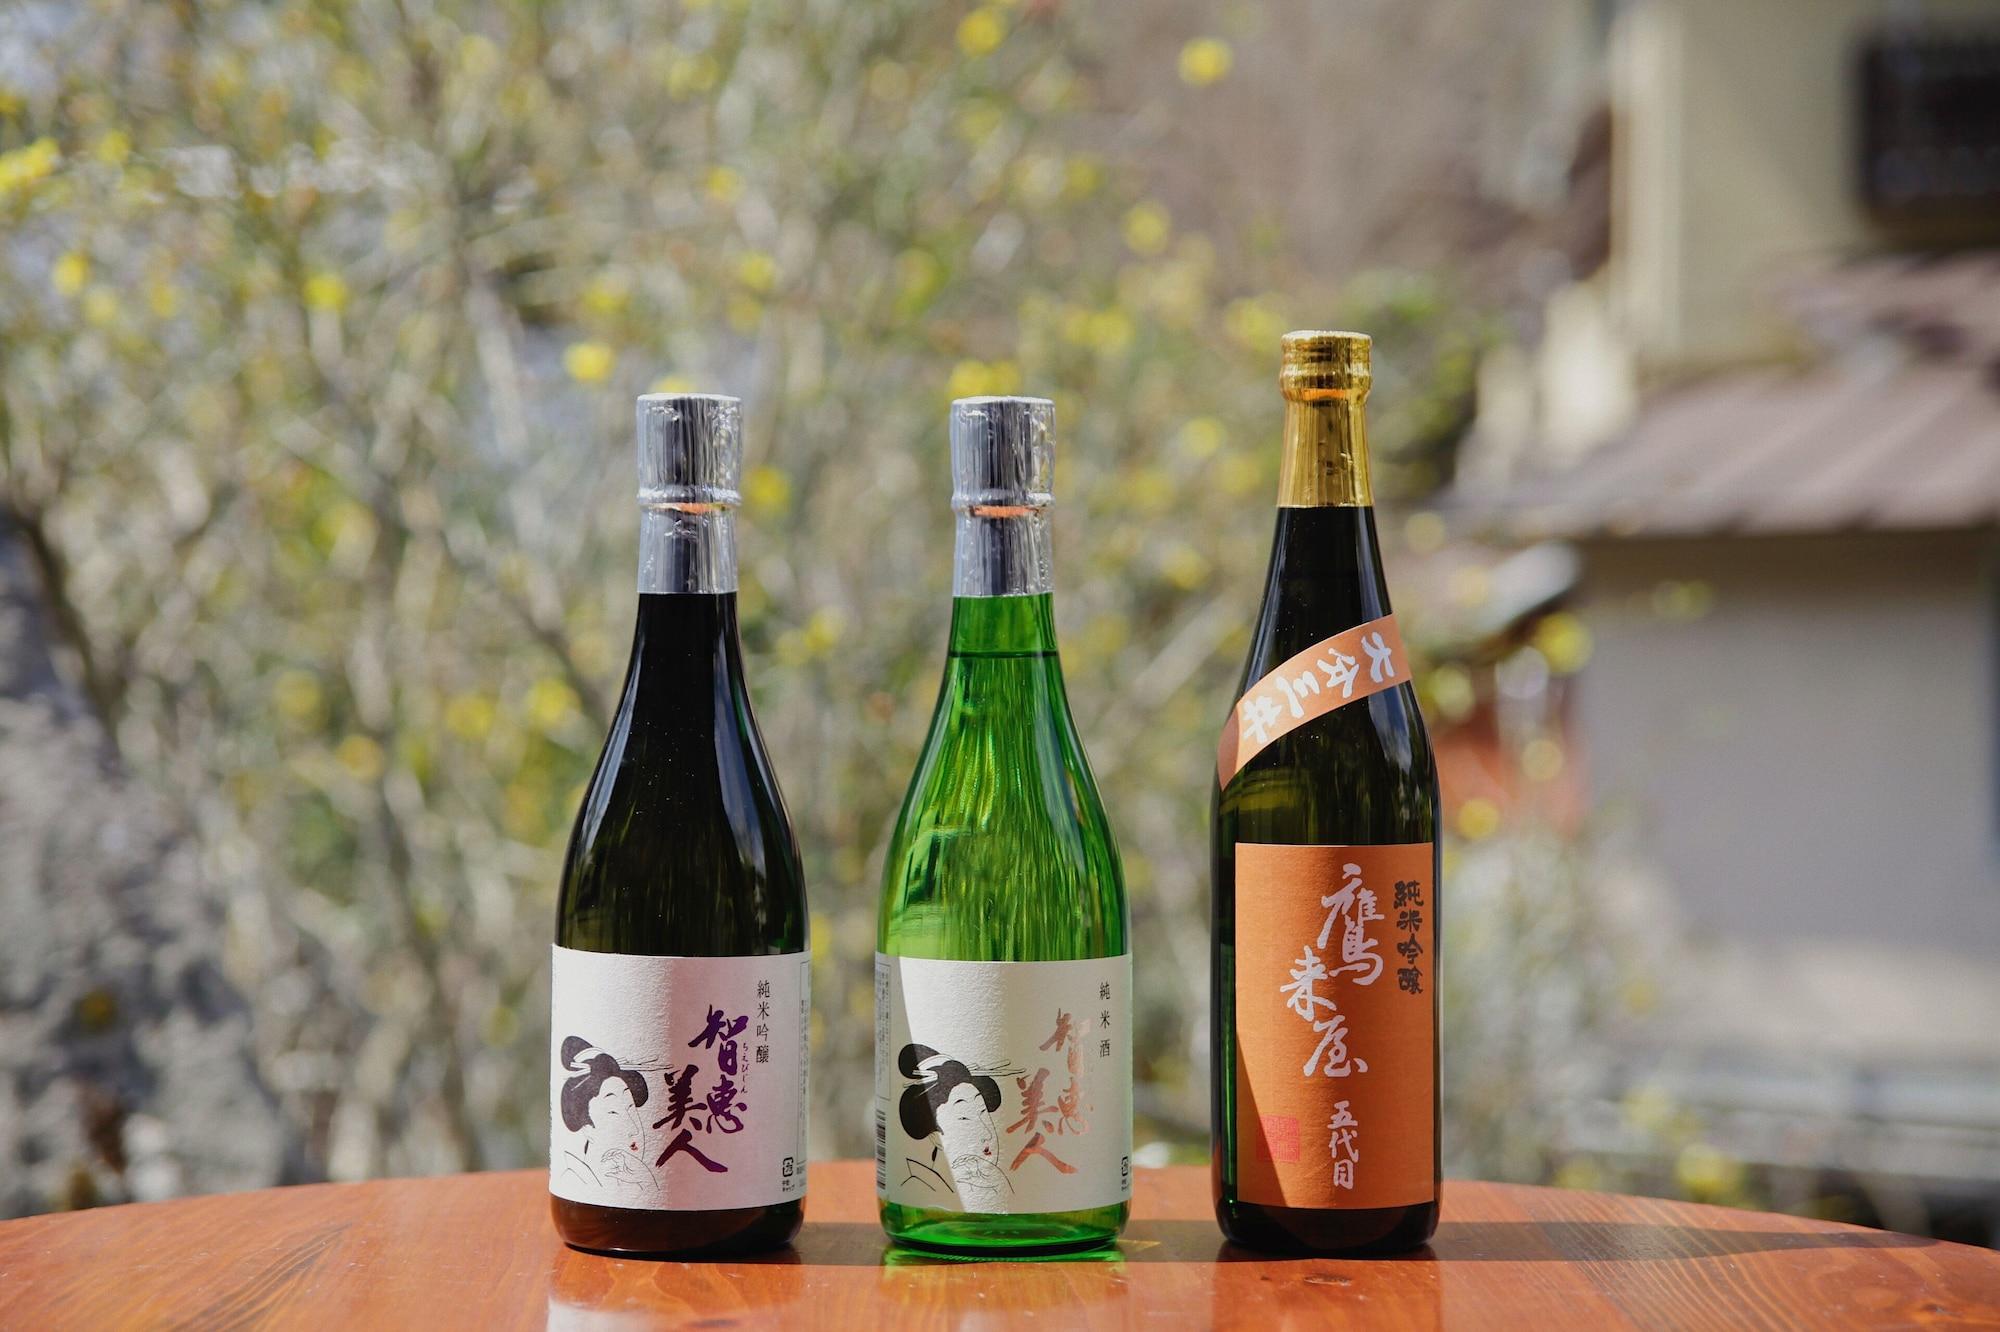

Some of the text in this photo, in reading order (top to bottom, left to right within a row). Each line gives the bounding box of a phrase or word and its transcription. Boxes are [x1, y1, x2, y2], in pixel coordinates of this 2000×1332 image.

[1393, 880, 1424, 995] 純米吟醸
[1099, 981, 1111, 1058] 純米酒
[1327, 1100, 1359, 1190] 五代目
